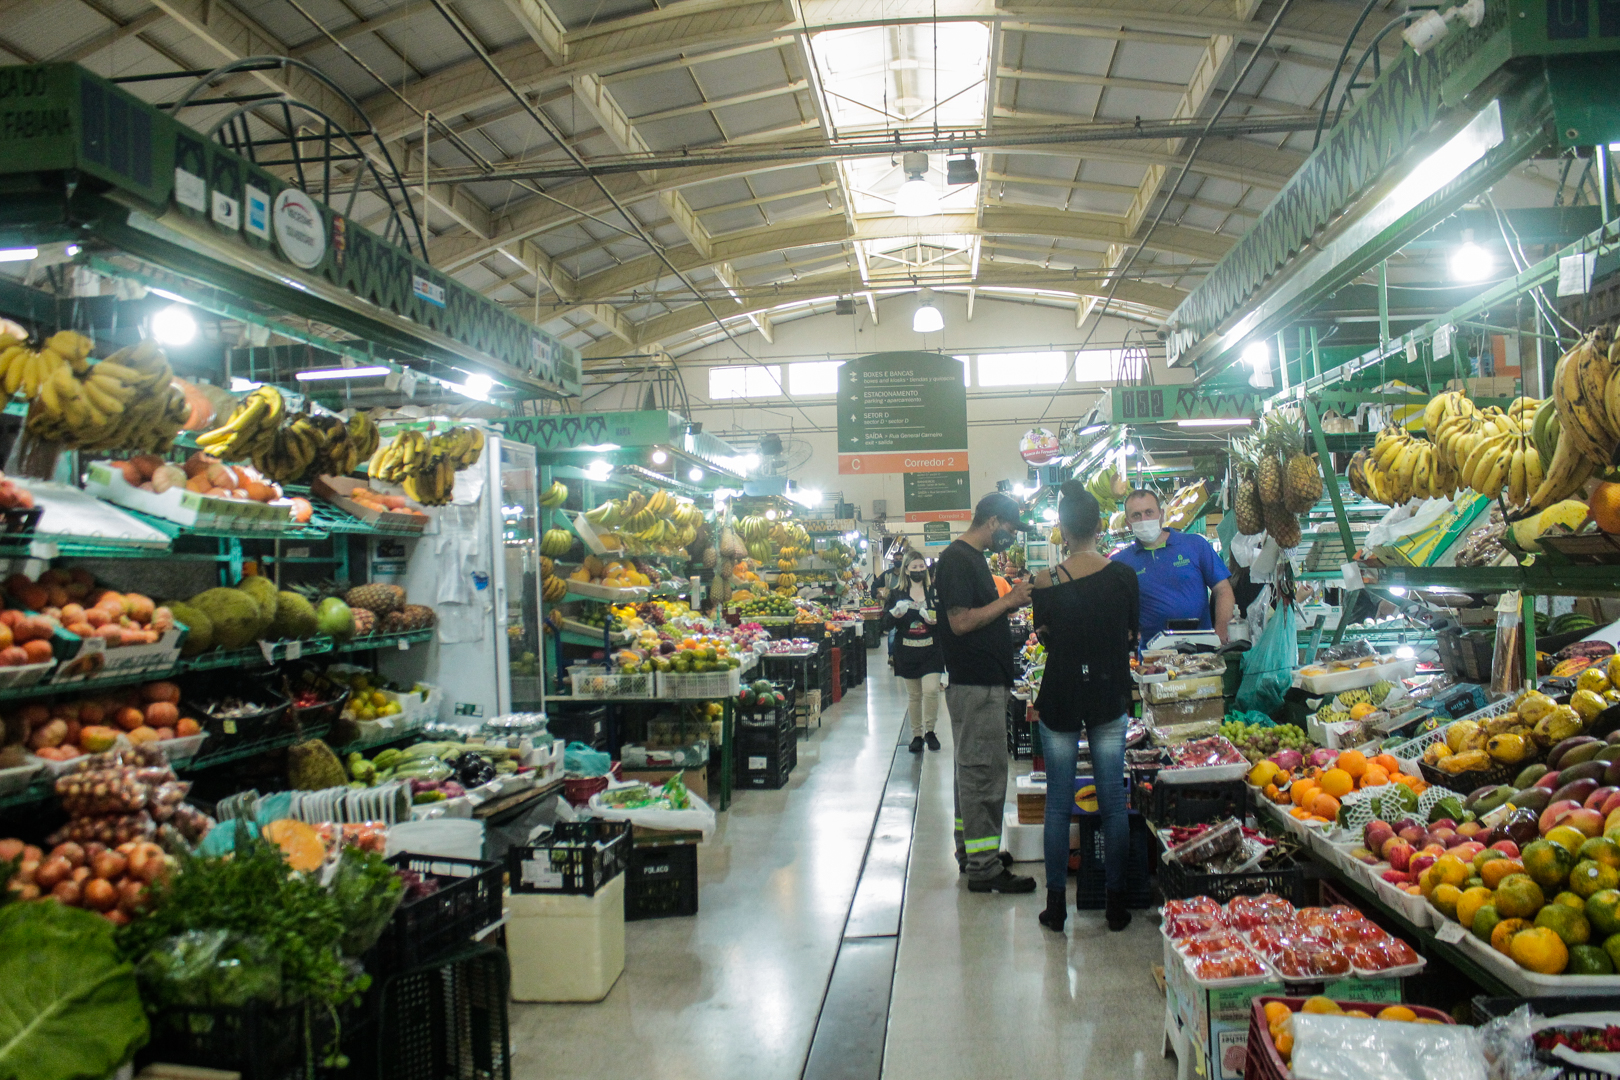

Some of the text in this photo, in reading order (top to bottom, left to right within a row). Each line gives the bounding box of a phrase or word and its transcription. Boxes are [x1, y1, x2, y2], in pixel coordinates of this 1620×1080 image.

[863, 390, 919, 398] ESTACIONAMENTO
[1124, 392, 1161, 415] 052
[864, 431, 883, 440] SAÍDA
[851, 457, 954, 470] C Corredor 2
